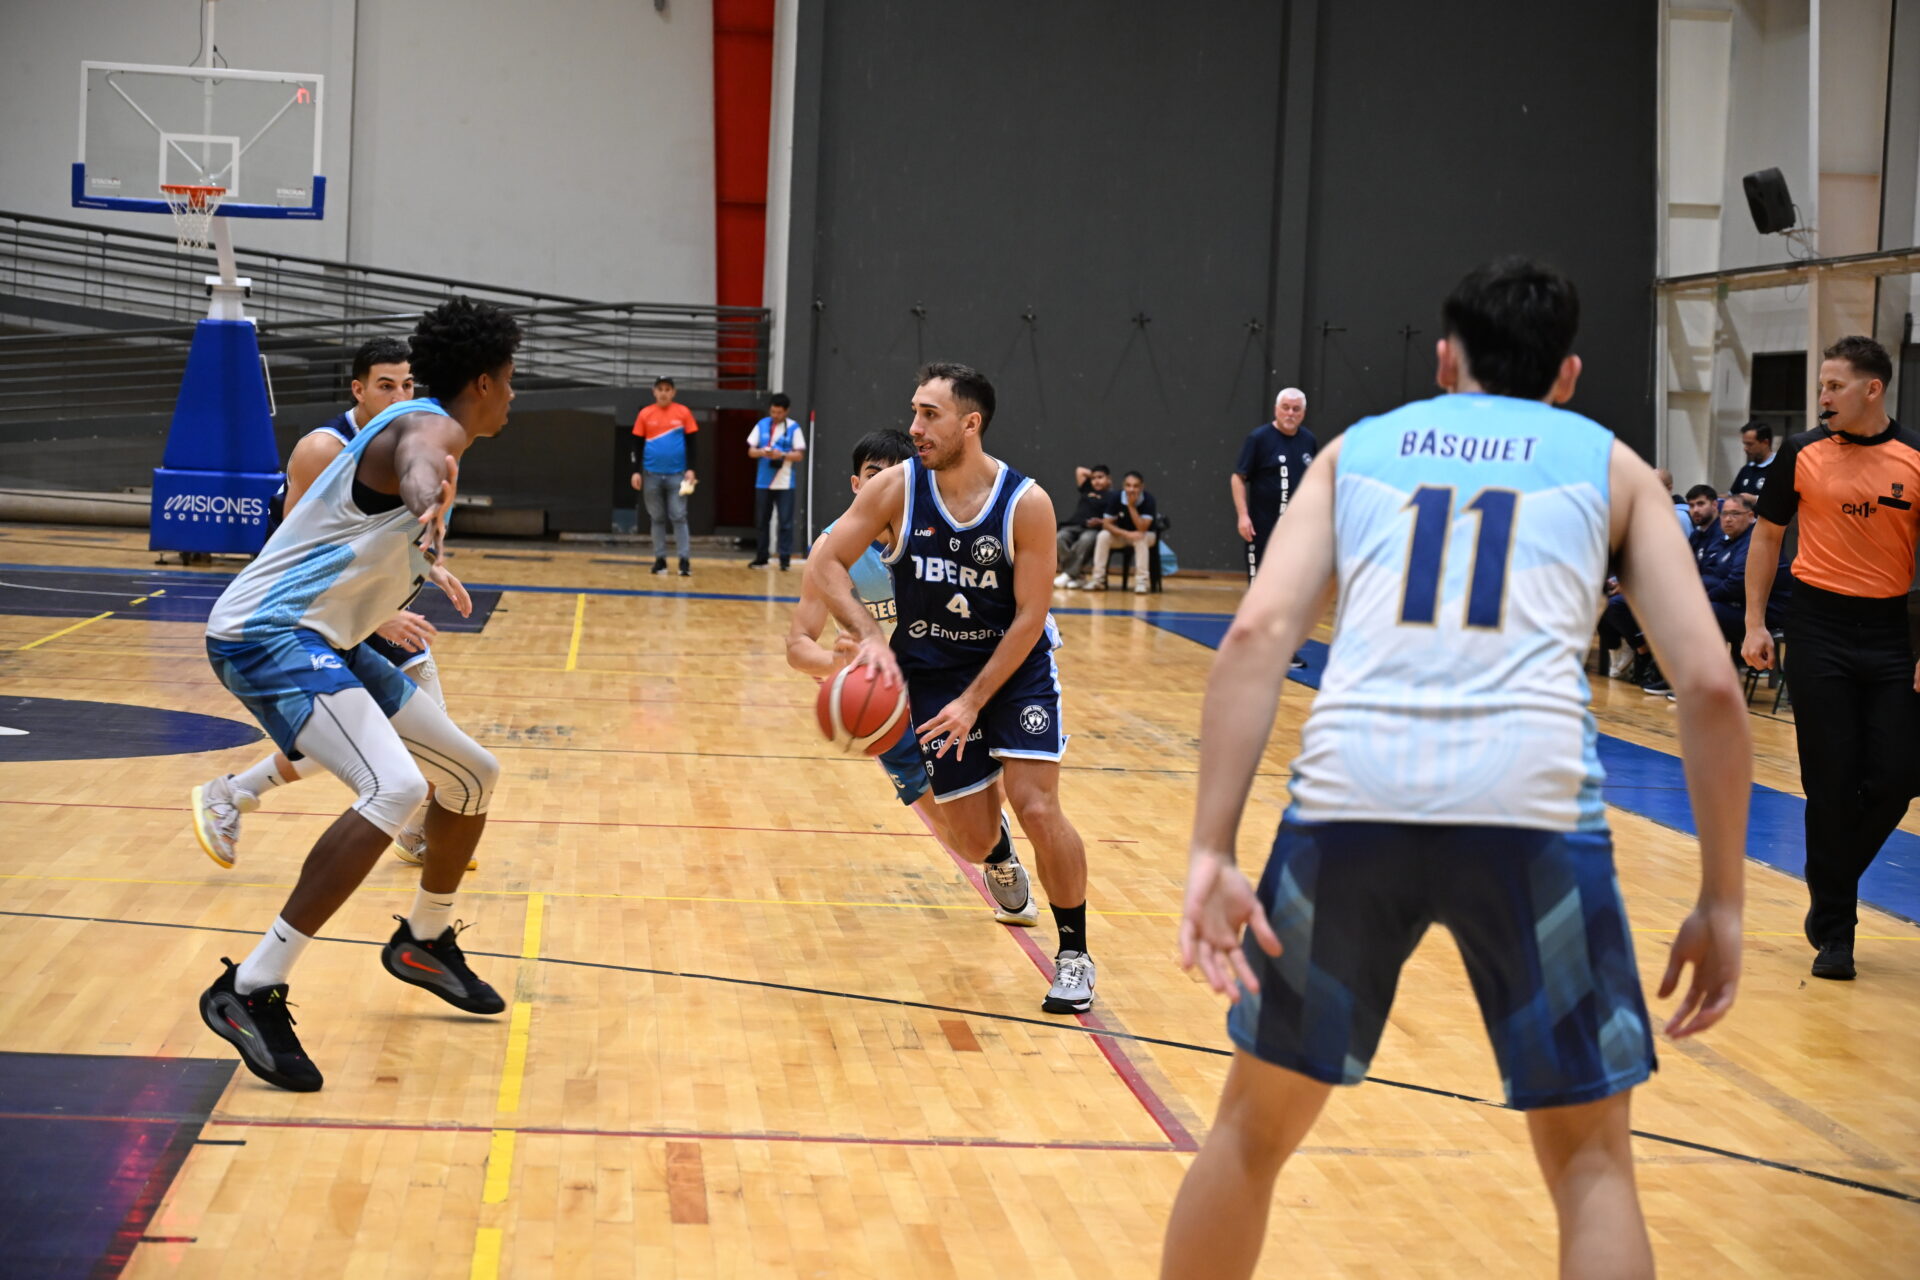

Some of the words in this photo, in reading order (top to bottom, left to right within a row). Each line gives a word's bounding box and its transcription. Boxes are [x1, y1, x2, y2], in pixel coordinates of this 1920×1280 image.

[164, 494, 262, 516] MISIONES
[164, 512, 260, 525] GOBIERNO
[914, 529, 932, 537] LNB
[1395, 483, 1523, 634] 11
[946, 593, 971, 618] 4
